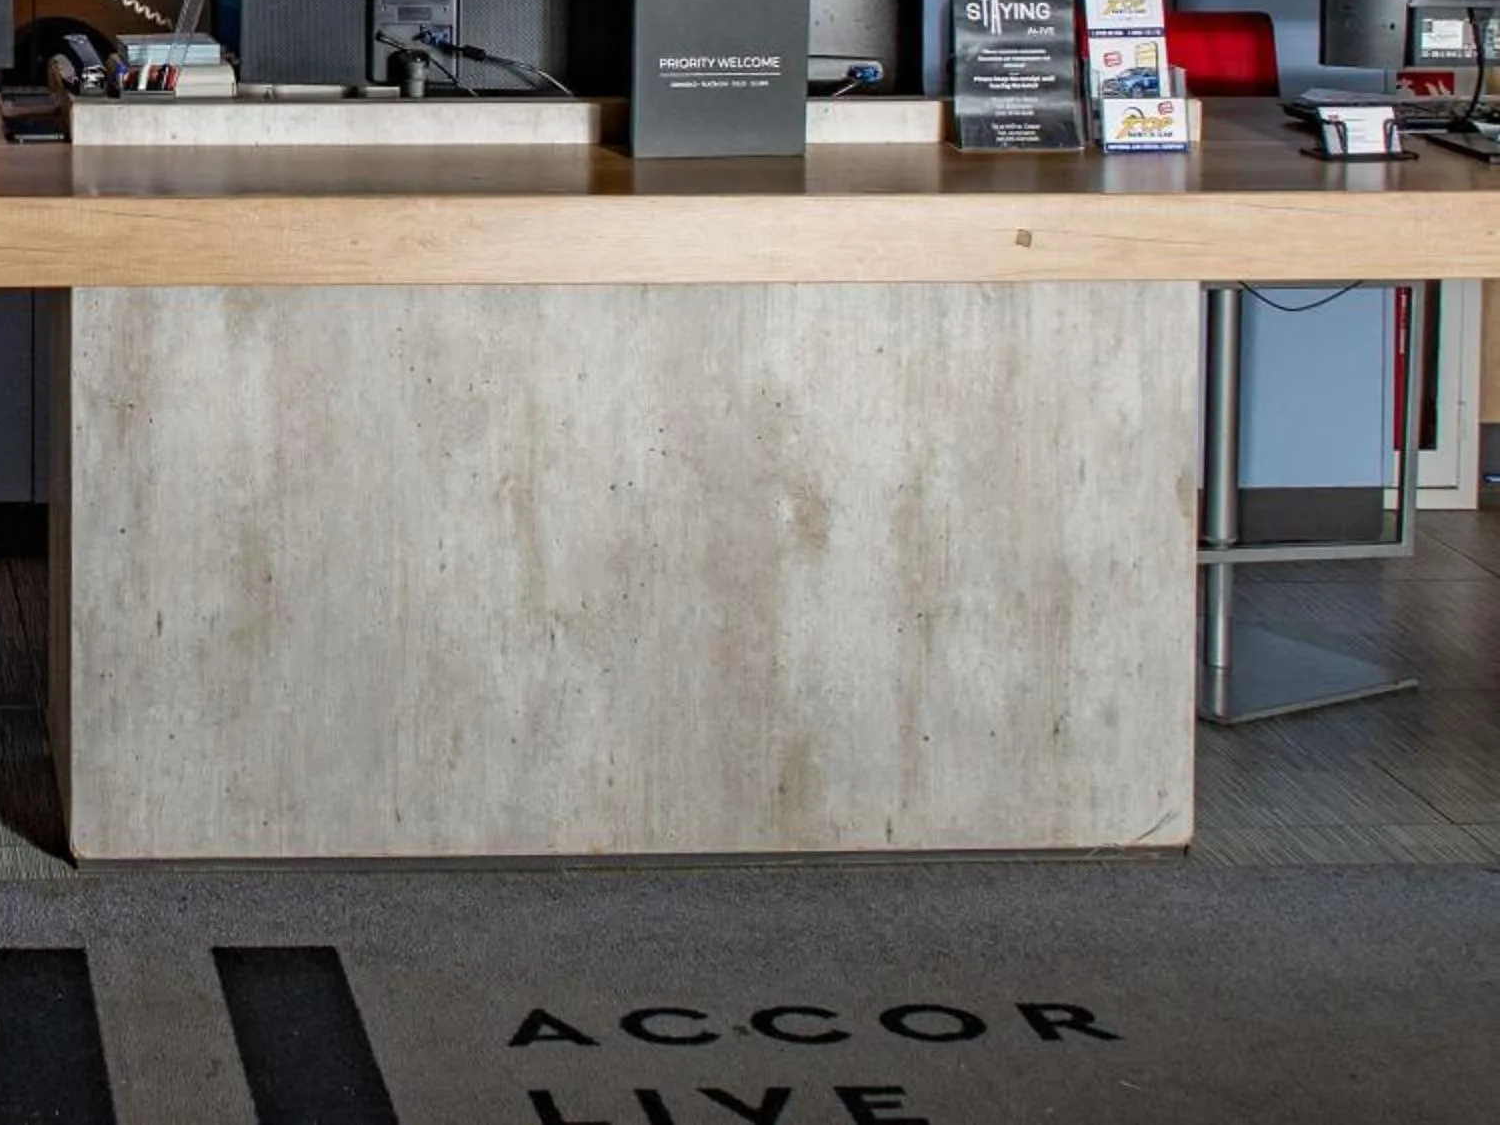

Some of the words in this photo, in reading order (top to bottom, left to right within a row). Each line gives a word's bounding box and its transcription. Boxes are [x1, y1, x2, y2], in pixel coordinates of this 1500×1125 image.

[659, 58, 715, 69] PRIORITY
[718, 56, 781, 68] WELCOME
[508, 1003, 1126, 1047] ACCOR
[528, 1086, 930, 1125] LIVE
